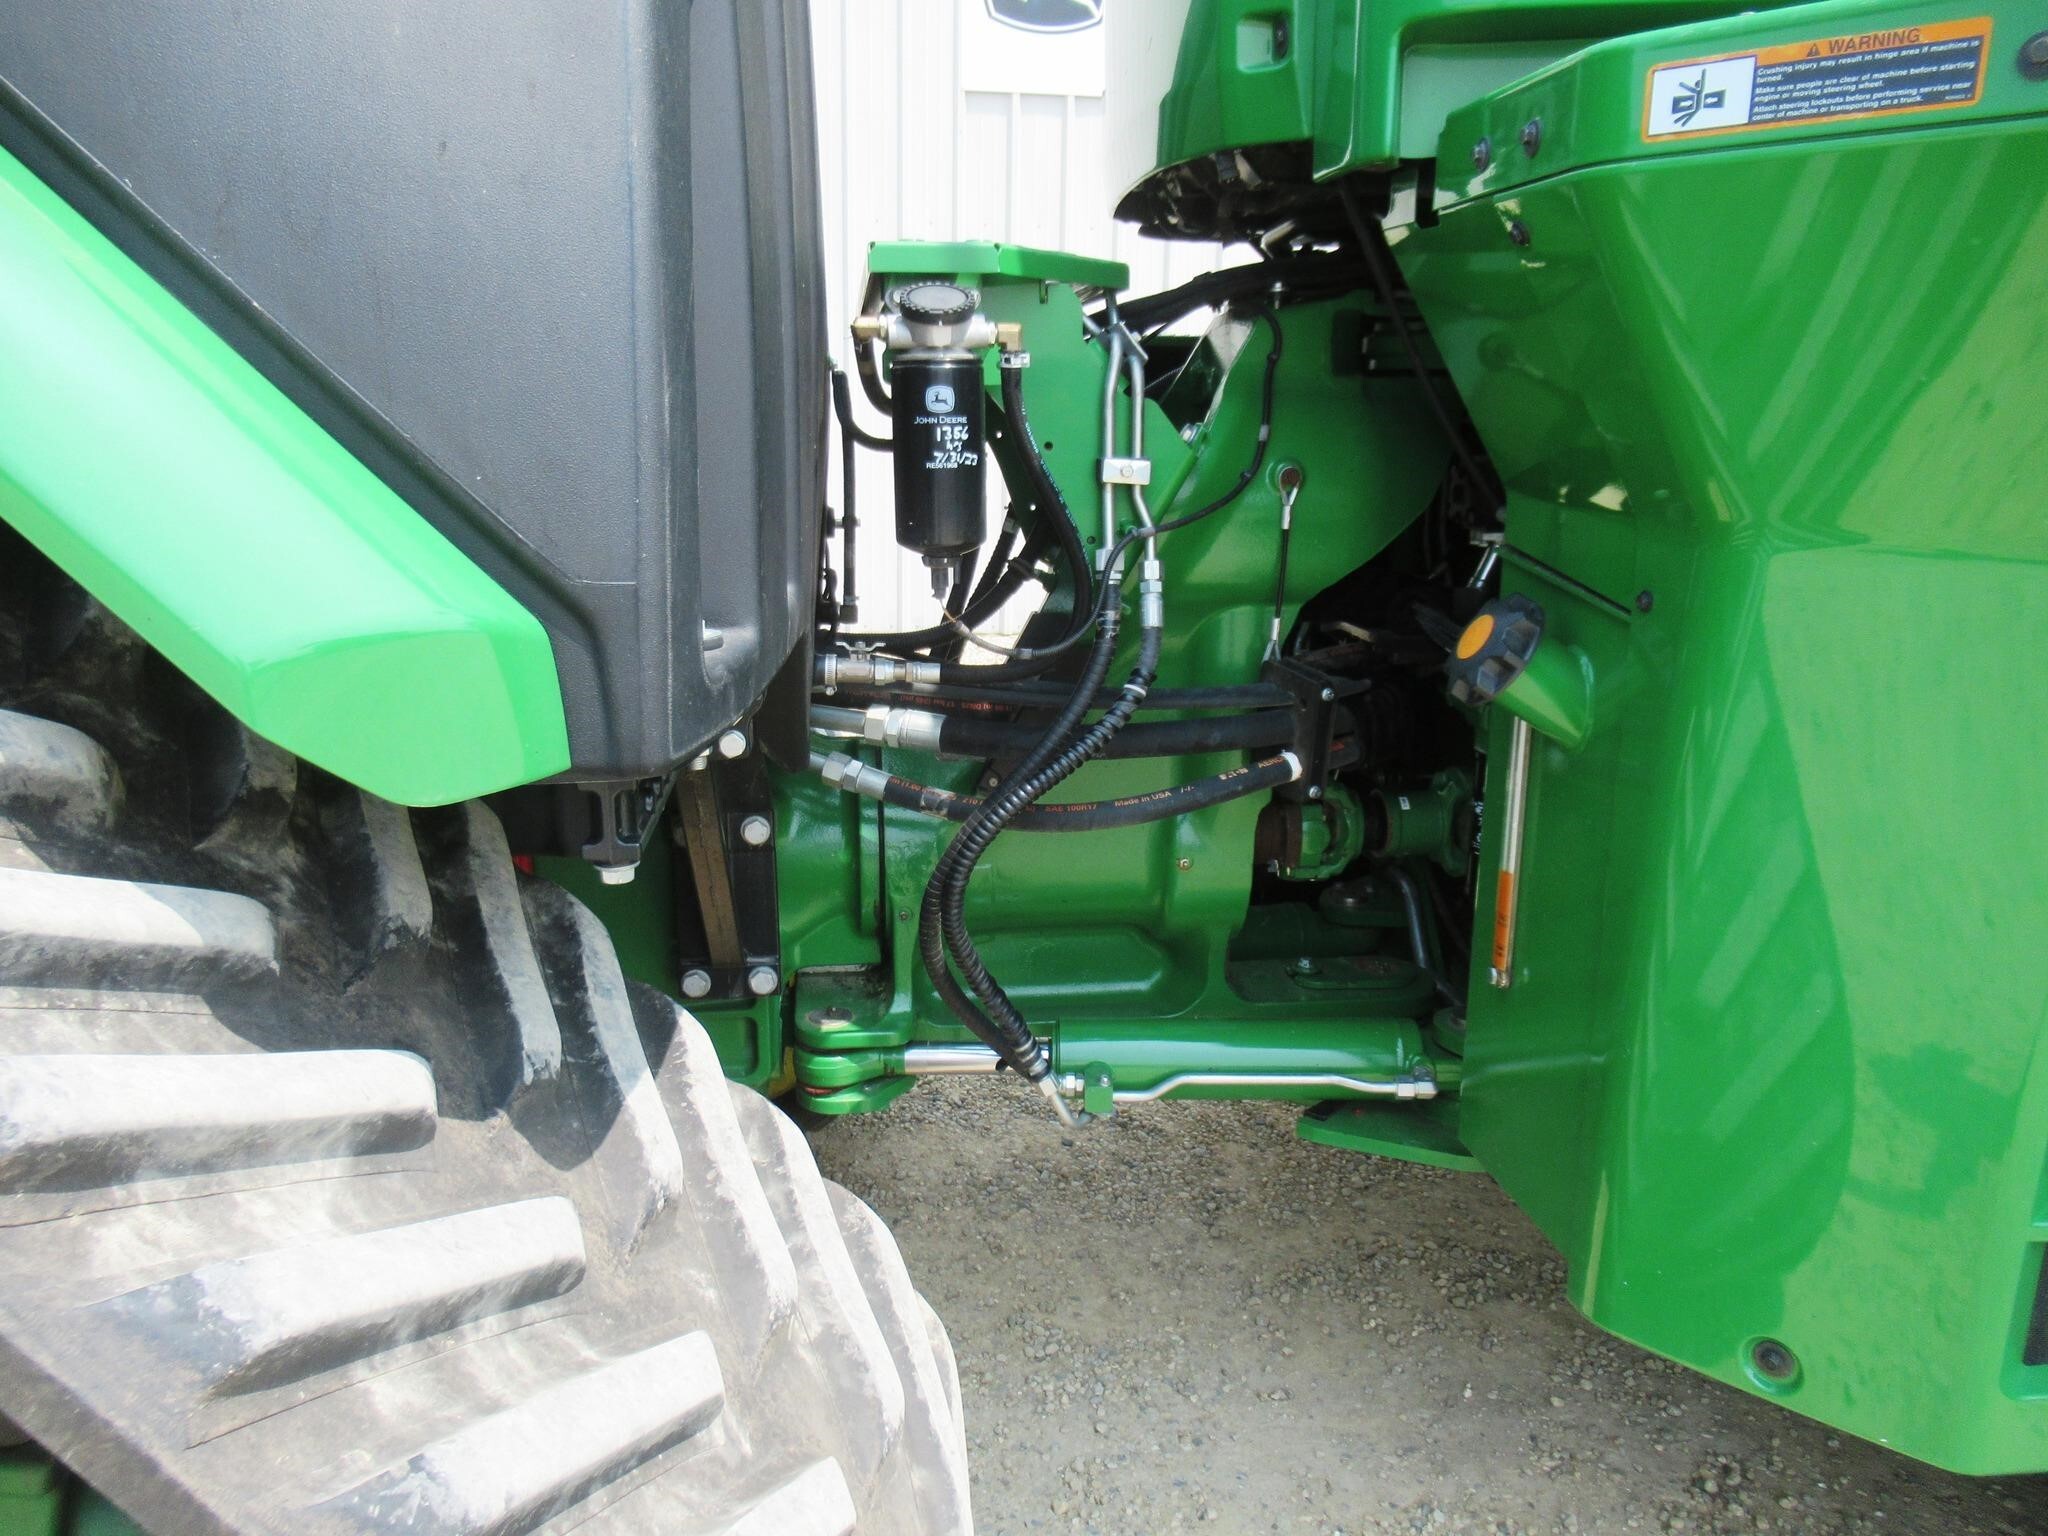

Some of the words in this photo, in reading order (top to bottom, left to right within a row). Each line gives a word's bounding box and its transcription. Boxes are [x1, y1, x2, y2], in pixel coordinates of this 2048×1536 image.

[1828, 28, 1921, 54] WARNING
[1758, 65, 1793, 75] Crushing
[1794, 61, 1818, 71] injury
[1819, 58, 1836, 67] may
[1838, 55, 1863, 64] result
[1874, 51, 1899, 60] hinge
[1900, 48, 1920, 56] area
[1921, 46, 1929, 54] if
[1930, 41, 1969, 52] machine
[1755, 86, 1776, 94] Make
[1776, 84, 1794, 92] sure
[1796, 80, 1823, 91] people
[1824, 78, 1838, 86] are
[1839, 75, 1860, 84] clear
[1872, 69, 1908, 79] machine
[1910, 66, 1939, 75] before
[1940, 61, 1976, 72] starting
[1756, 74, 1784, 83] turned.
[1753, 104, 1778, 113] Attach
[1778, 100, 1810, 110] steering
[1810, 96, 1844, 106] lockouts
[1845, 92, 1871, 102] before
[1872, 87, 1918, 100] performing
[1919, 84, 1952, 93] service
[1952, 81, 1973, 90] near
[1754, 93, 1781, 103] engine
[1792, 88, 1822, 98] moving
[1823, 84, 1857, 94] steering
[1858, 80, 1884, 89] wheel.
[1752, 113, 1775, 121] center
[1776, 110, 1786, 118] of
[1786, 107, 1819, 117] machine
[1830, 100, 1879, 112] transporting
[1899, 95, 1924, 104] truck.
[913, 416, 938, 425] JOHN
[939, 416, 968, 424] DEERE
[936, 426, 969, 442] 1356
[1114, 798, 1141, 808] Made
[1151, 790, 1173, 802] USA
